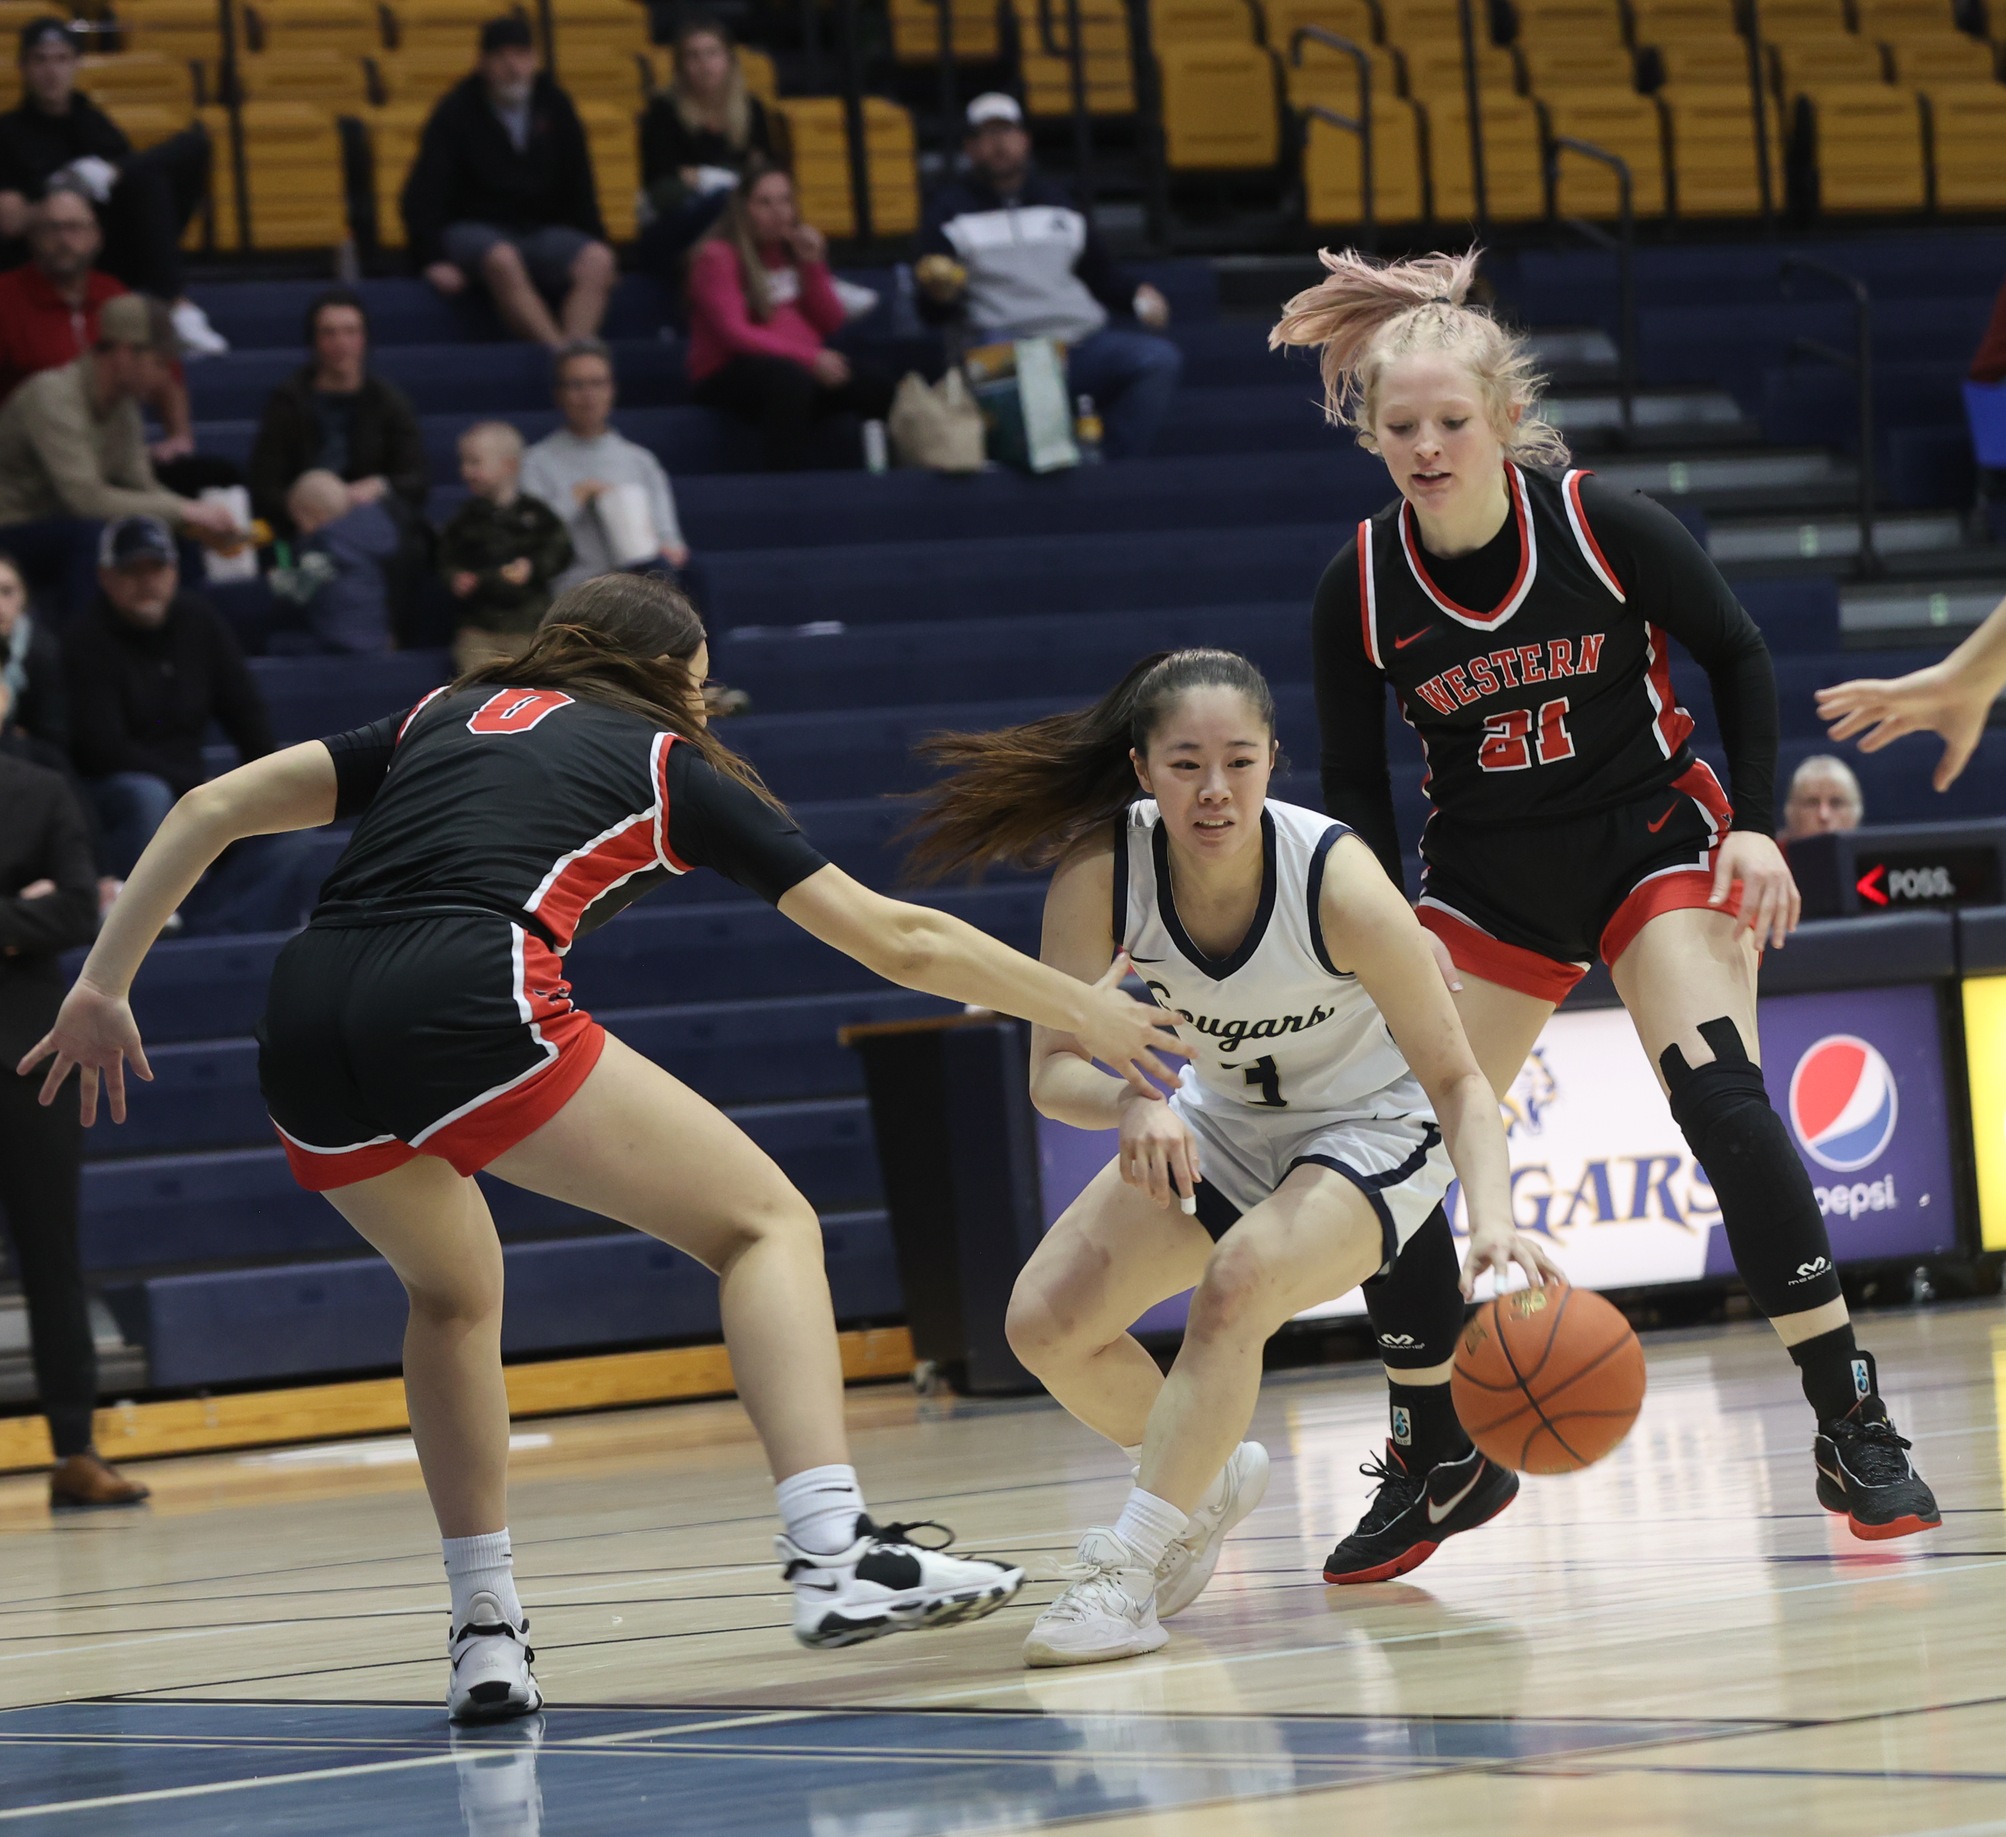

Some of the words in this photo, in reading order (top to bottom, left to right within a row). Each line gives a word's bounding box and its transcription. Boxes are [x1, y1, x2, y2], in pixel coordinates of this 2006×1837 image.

[466, 688, 576, 735] 0
[1415, 633, 1605, 715] WESTERN
[1478, 696, 1576, 773] 21
